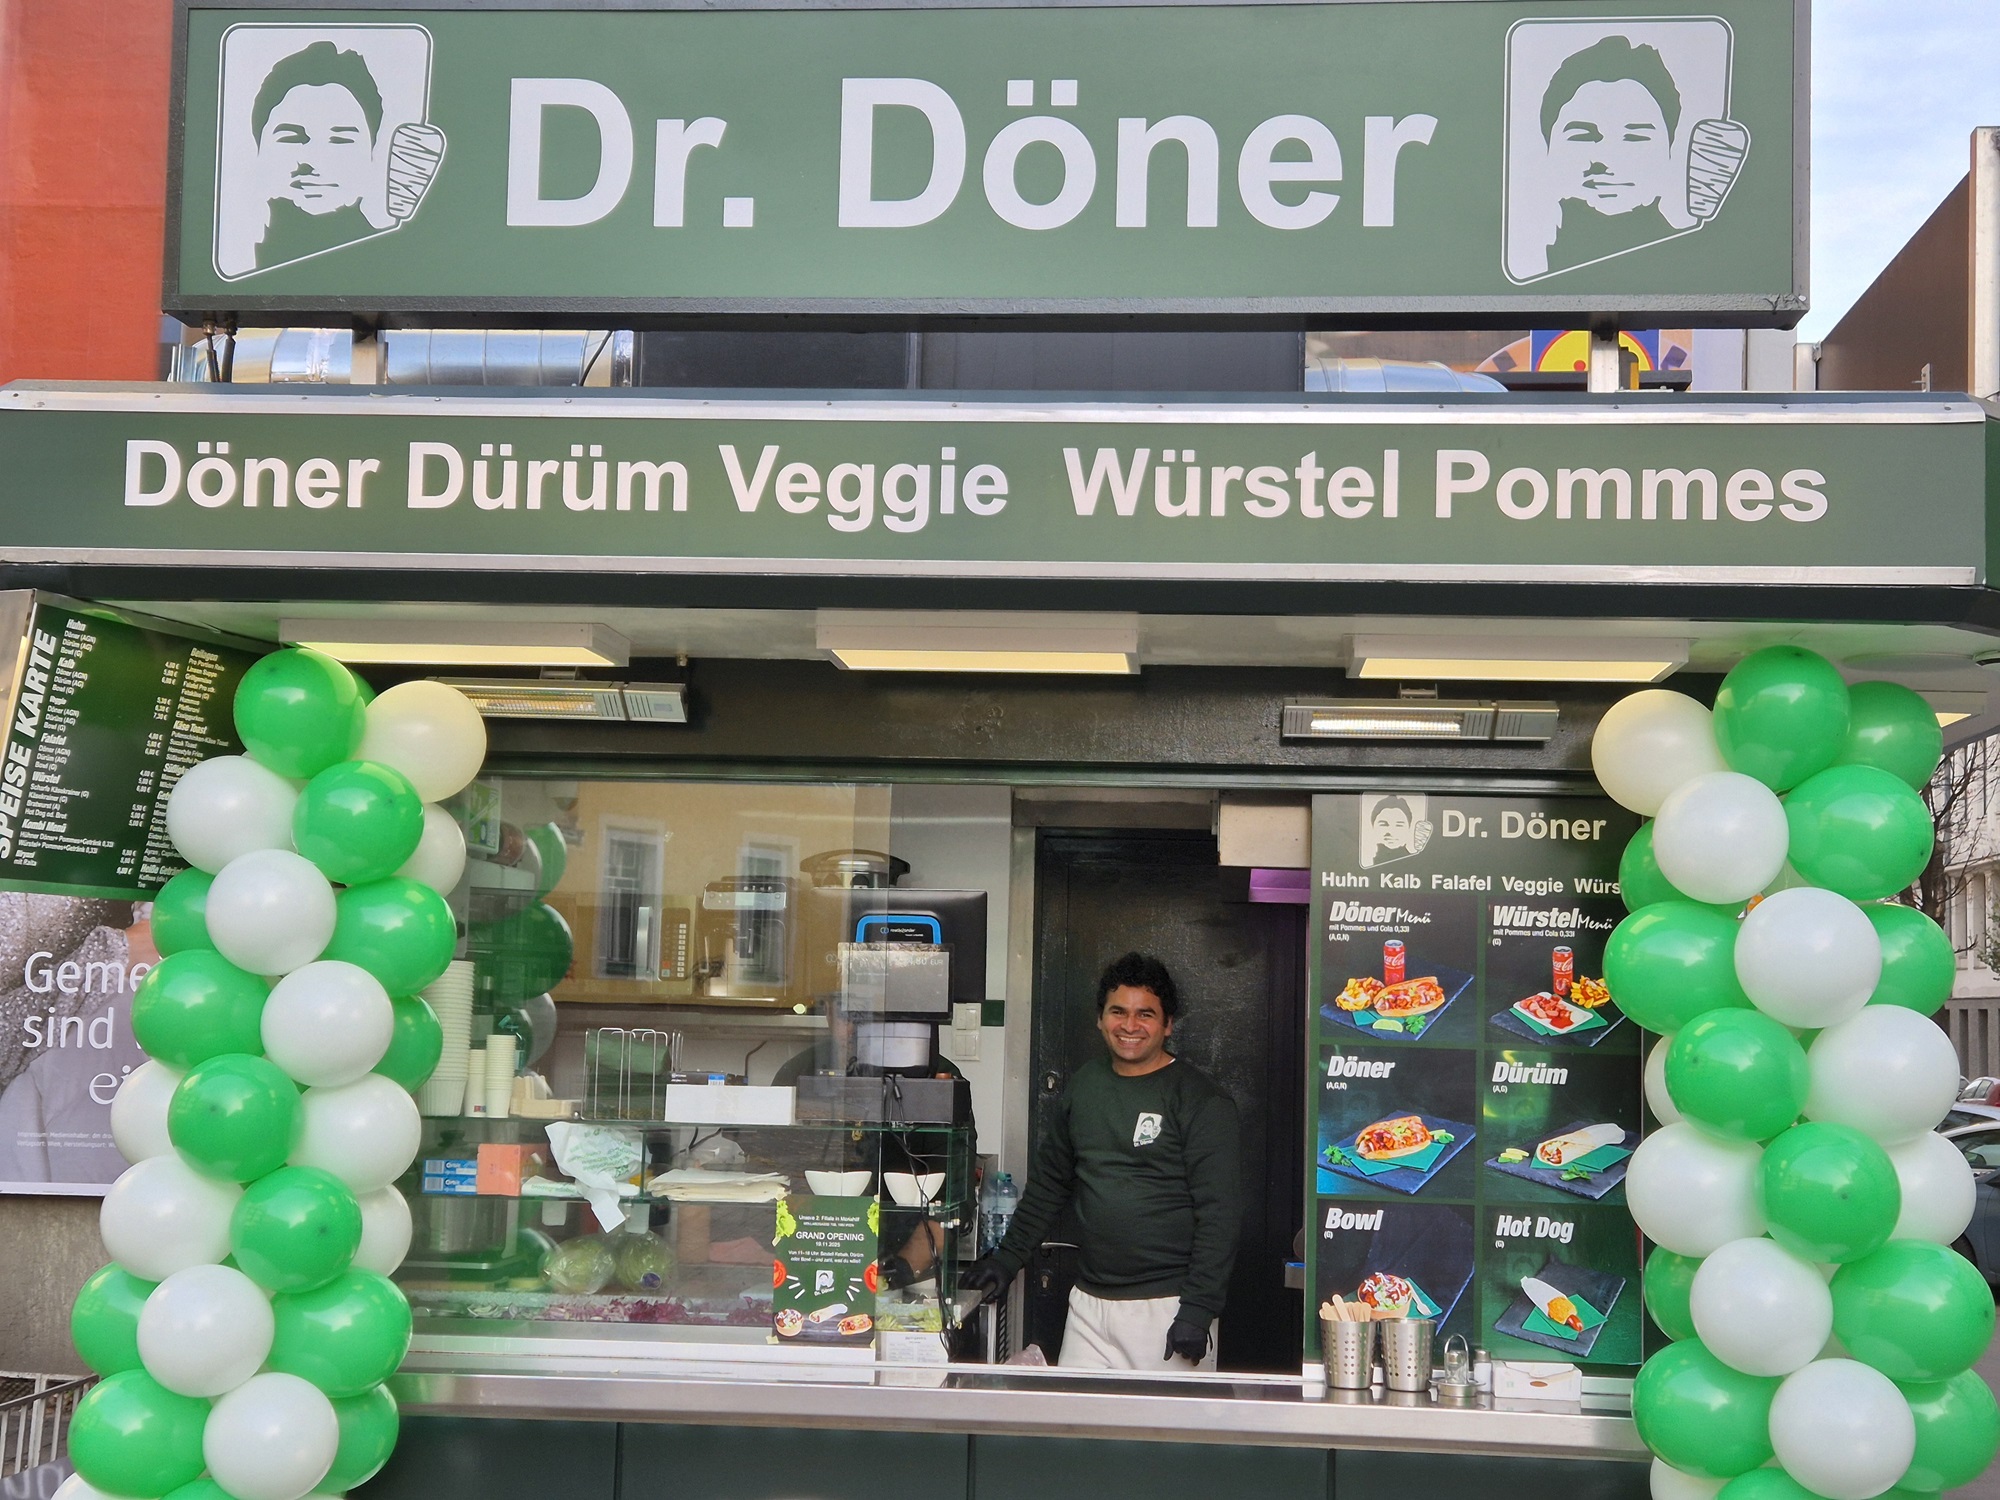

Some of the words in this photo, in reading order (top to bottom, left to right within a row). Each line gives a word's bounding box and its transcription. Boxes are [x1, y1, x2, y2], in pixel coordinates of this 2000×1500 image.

[506, 77, 756, 230] Dr.
[837, 77, 1439, 231] Döner
[124, 438, 382, 509] Döner
[405, 441, 690, 513] Dürüm
[718, 444, 1010, 533] Veggie
[1061, 447, 1400, 519] Würstel
[1435, 448, 1829, 523] Pommes
[15, 628, 57, 738] KARTE
[40, 733, 67, 746] Falafel
[0, 741, 31, 859] SPEISE
[1441, 808, 1488, 839] Dr.
[1501, 810, 1607, 841] Döner
[1321, 871, 1369, 888] Huhn
[1380, 873, 1422, 889] Kalb
[1431, 874, 1492, 891] Falafel
[1501, 876, 1564, 896] Veggie
[1574, 877, 1621, 895] Würs
[1329, 901, 1397, 923] Döner
[1493, 905, 1580, 928] Würstel
[1328, 924, 1340, 932] mit
[1340, 924, 1367, 932] Pommes
[1379, 925, 1394, 933] Cola
[1504, 929, 1532, 937] Pommes
[24, 951, 150, 994] Geme
[22, 1007, 115, 1050] sind
[1327, 1055, 1396, 1079] Döner
[1492, 1061, 1569, 1086] Dürüm
[1325, 1207, 1385, 1232] Bowl
[1496, 1214, 1532, 1239] Hot
[1534, 1216, 1575, 1245] Dog
[795, 1231, 826, 1241] GRAND
[826, 1232, 865, 1242] OPENING
